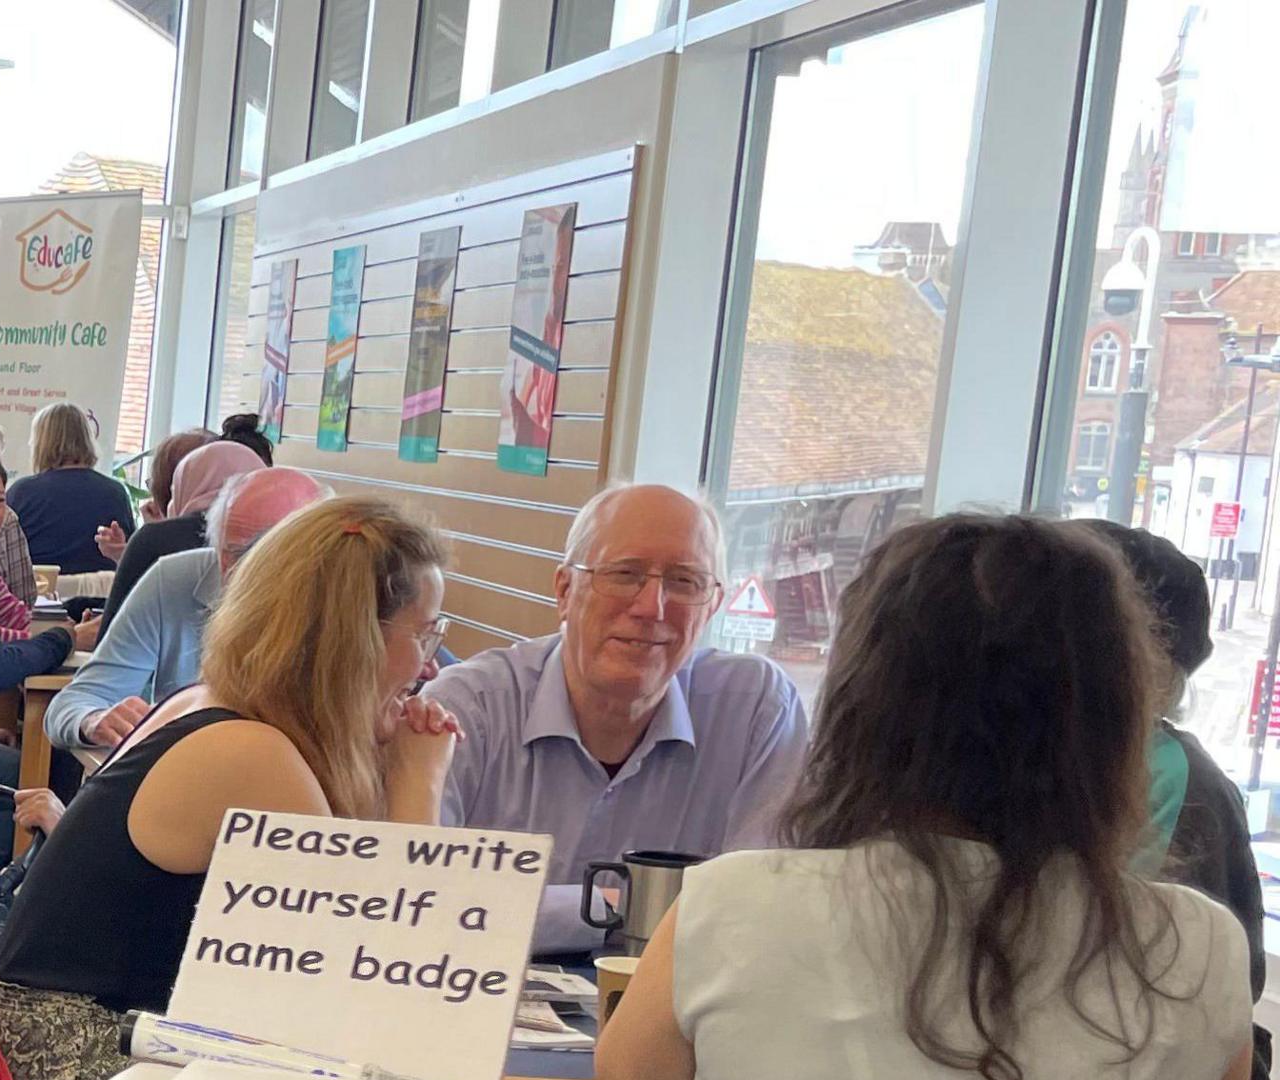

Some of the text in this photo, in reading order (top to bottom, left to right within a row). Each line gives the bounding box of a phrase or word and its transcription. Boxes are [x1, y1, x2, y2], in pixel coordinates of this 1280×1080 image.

[27, 234, 93, 268] Educafe
[71, 322, 107, 347] Cafe
[19, 361, 42, 374] Floor
[7, 387, 20, 396] and
[22, 388, 42, 397] Greet
[223, 812, 541, 874] Please write
[222, 881, 488, 931] yourself a
[195, 936, 509, 1002] name badge
